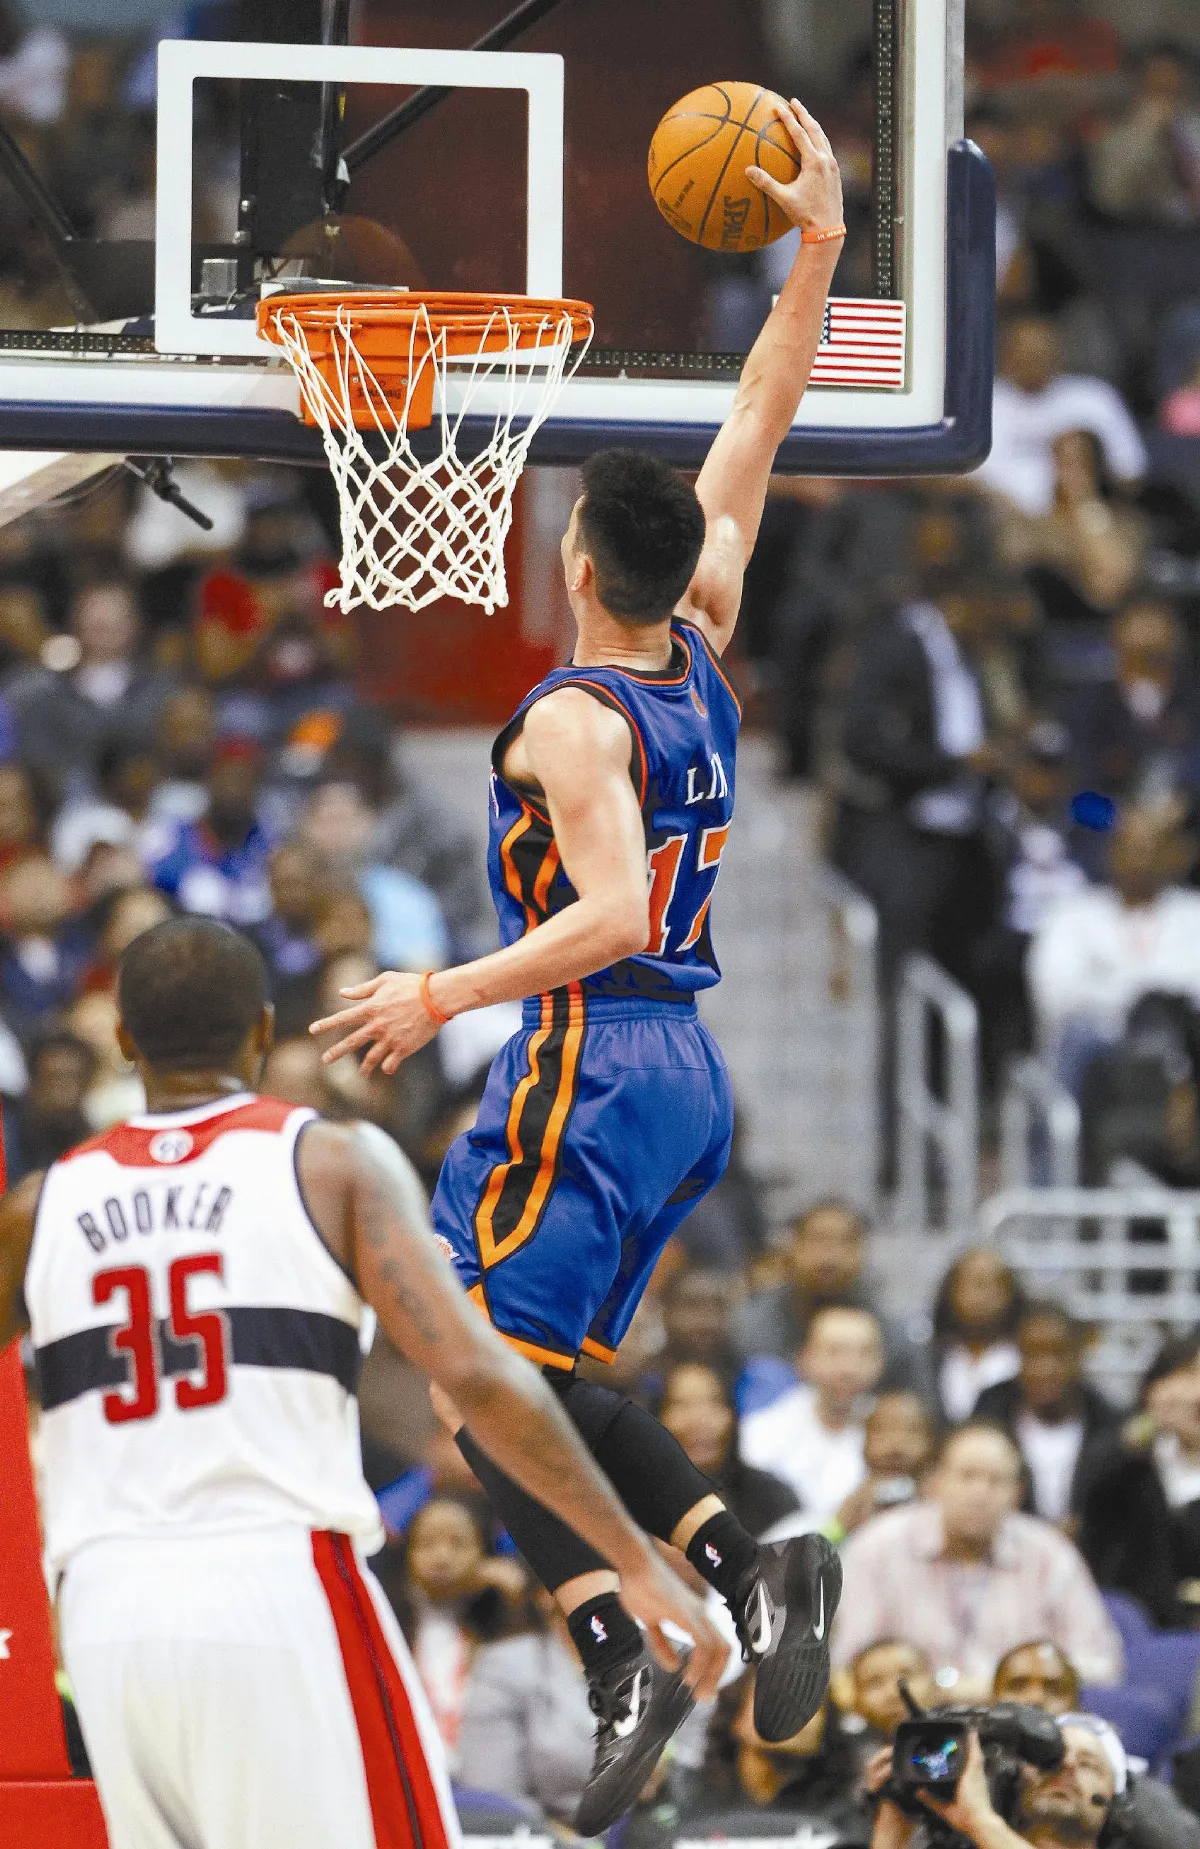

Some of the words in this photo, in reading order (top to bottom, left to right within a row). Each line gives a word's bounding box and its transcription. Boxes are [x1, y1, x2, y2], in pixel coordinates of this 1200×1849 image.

[642, 820, 733, 956] 17
[77, 1184, 233, 1254] BOOKER
[91, 1251, 232, 1425] 35
